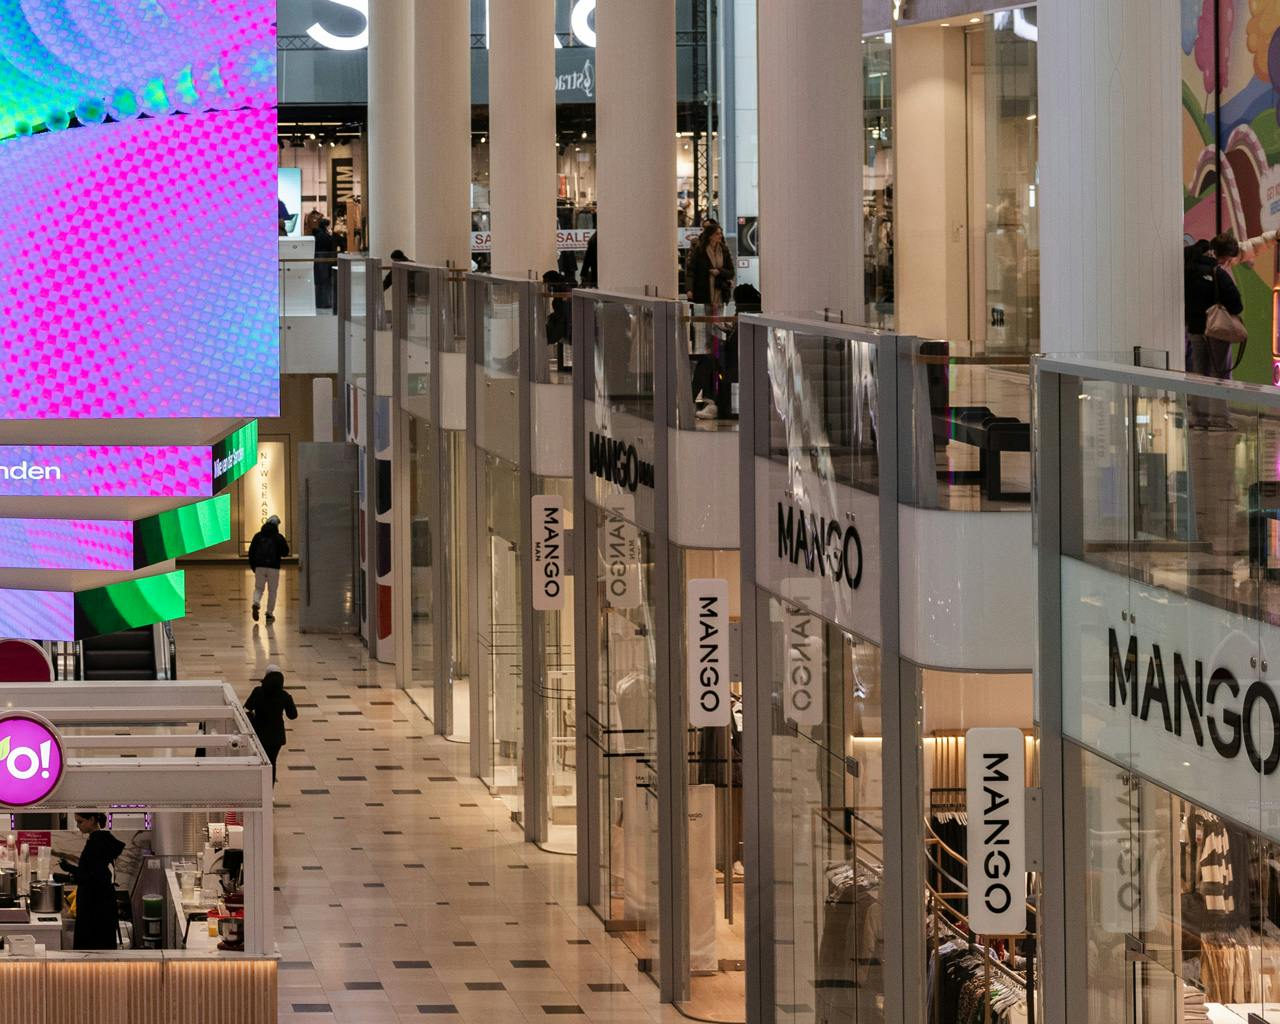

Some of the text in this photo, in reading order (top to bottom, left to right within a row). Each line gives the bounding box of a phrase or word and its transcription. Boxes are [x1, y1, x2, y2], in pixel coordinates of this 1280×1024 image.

[557, 231, 590, 244] SALE
[589, 432, 638, 492] MANGO
[544, 507, 560, 597] MANGO
[778, 502, 863, 590] MANGO
[699, 597, 720, 712] MANGO
[1108, 628, 1280, 775] MANGO
[983, 753, 1012, 914] MANGO
